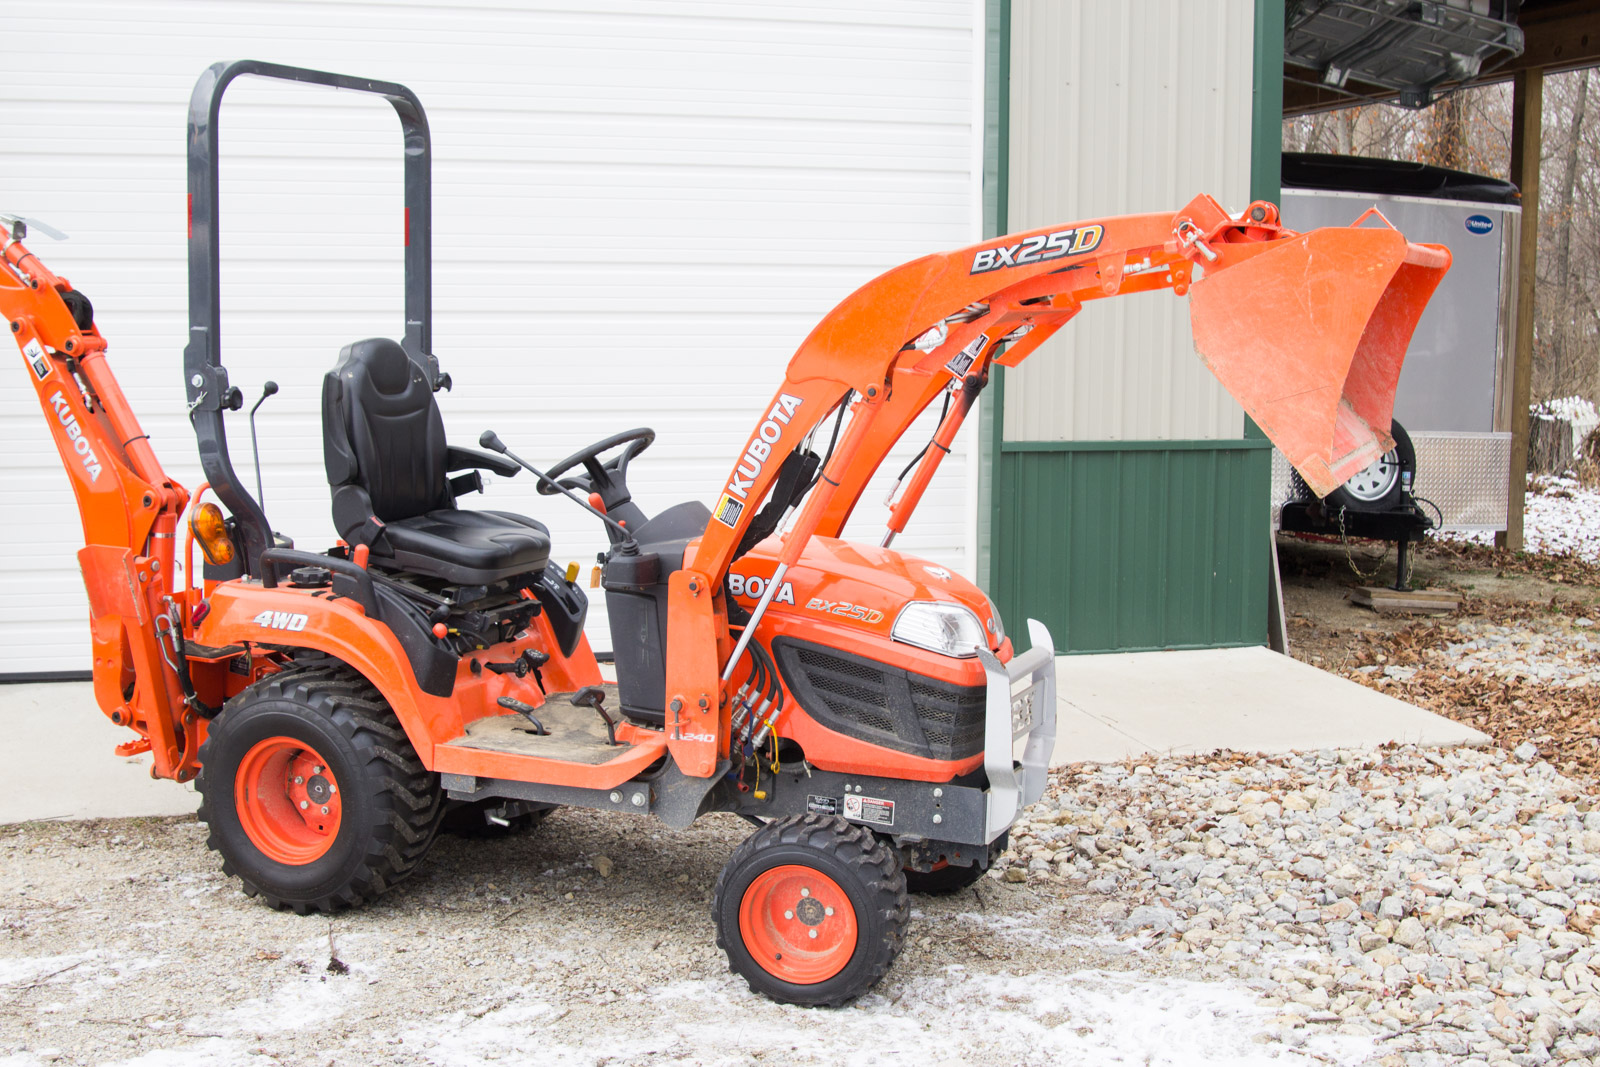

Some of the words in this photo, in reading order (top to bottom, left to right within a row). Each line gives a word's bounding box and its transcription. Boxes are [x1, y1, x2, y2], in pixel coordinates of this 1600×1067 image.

[970, 224, 1105, 275] BX25D
[49, 390, 103, 483] KUBOTA
[728, 392, 804, 500] KUBOTA
[253, 610, 309, 632] 4WD
[805, 597, 885, 624] BX25D
